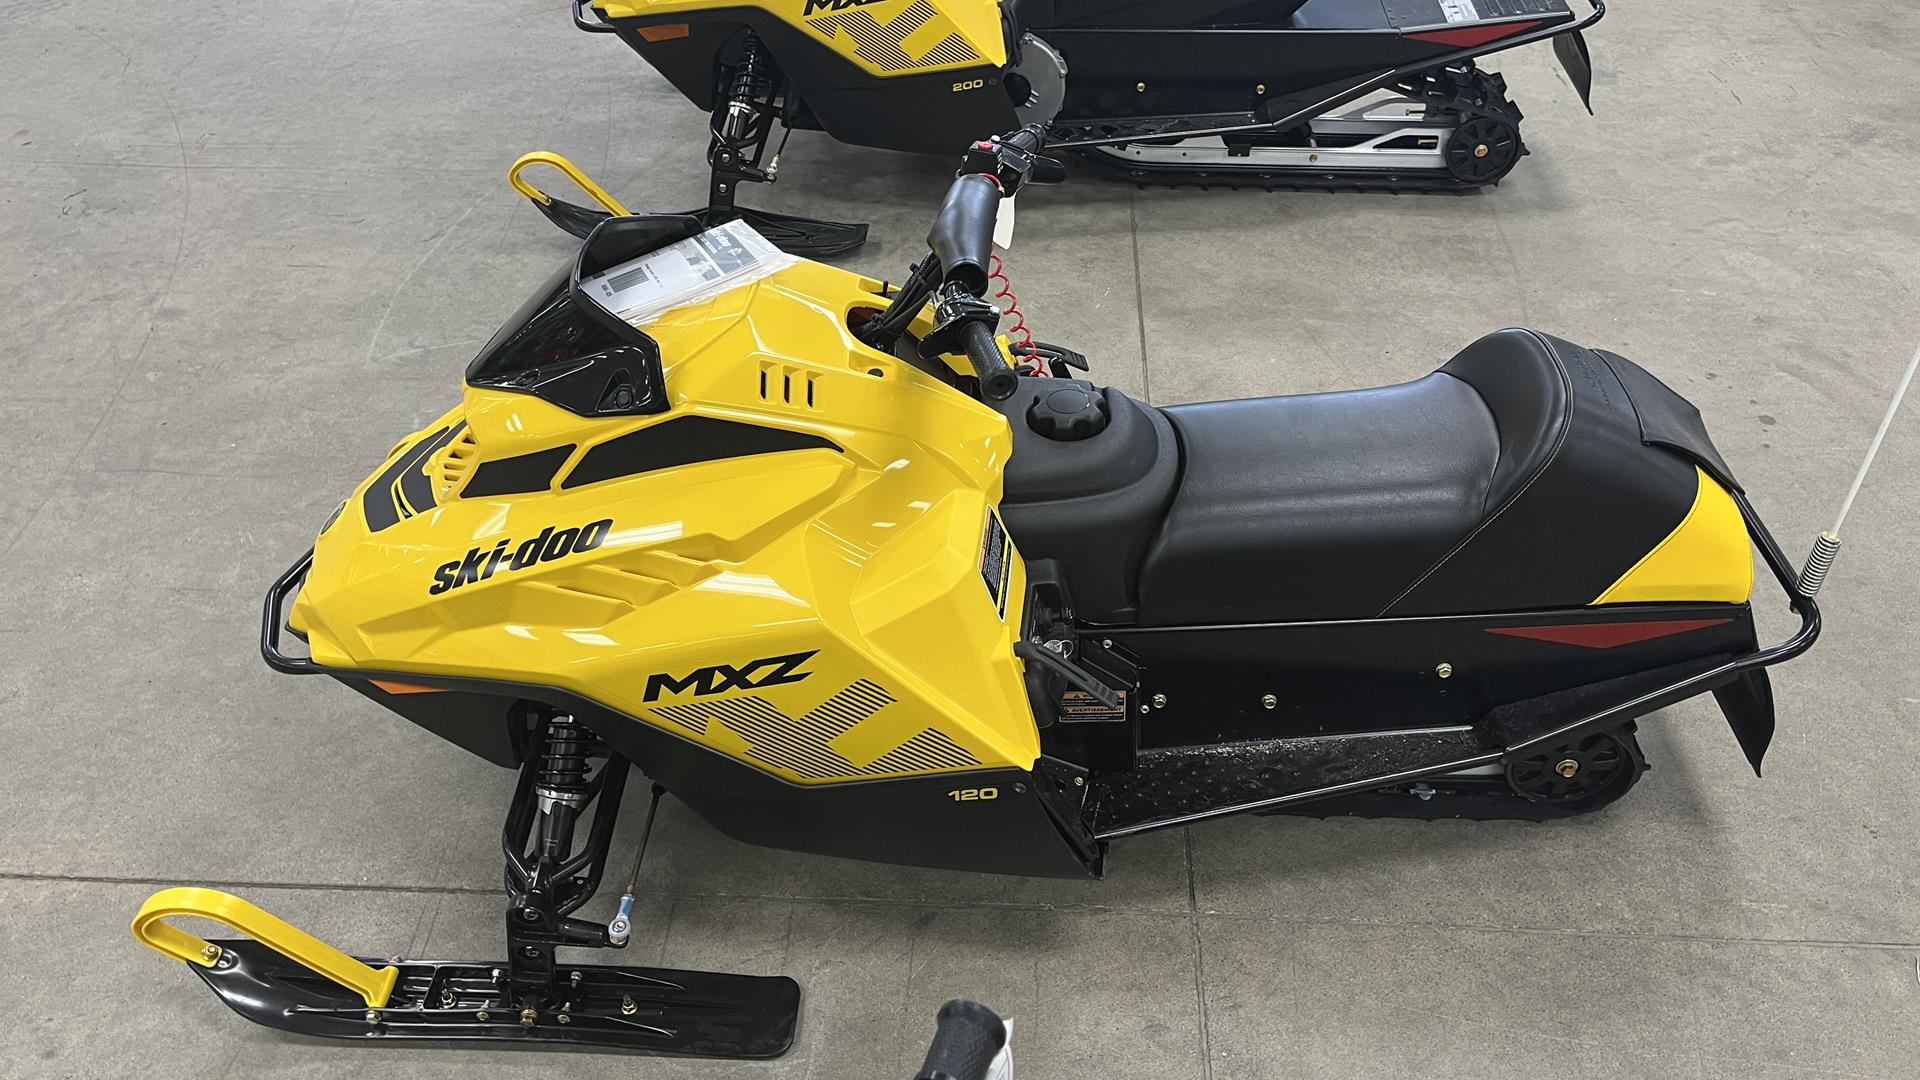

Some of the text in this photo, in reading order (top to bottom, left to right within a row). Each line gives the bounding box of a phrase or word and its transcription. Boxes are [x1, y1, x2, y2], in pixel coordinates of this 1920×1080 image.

[952, 79, 984, 92] 200
[429, 518, 614, 596] ski-doo
[642, 649, 822, 703] MXZ
[947, 787, 998, 801] 120
